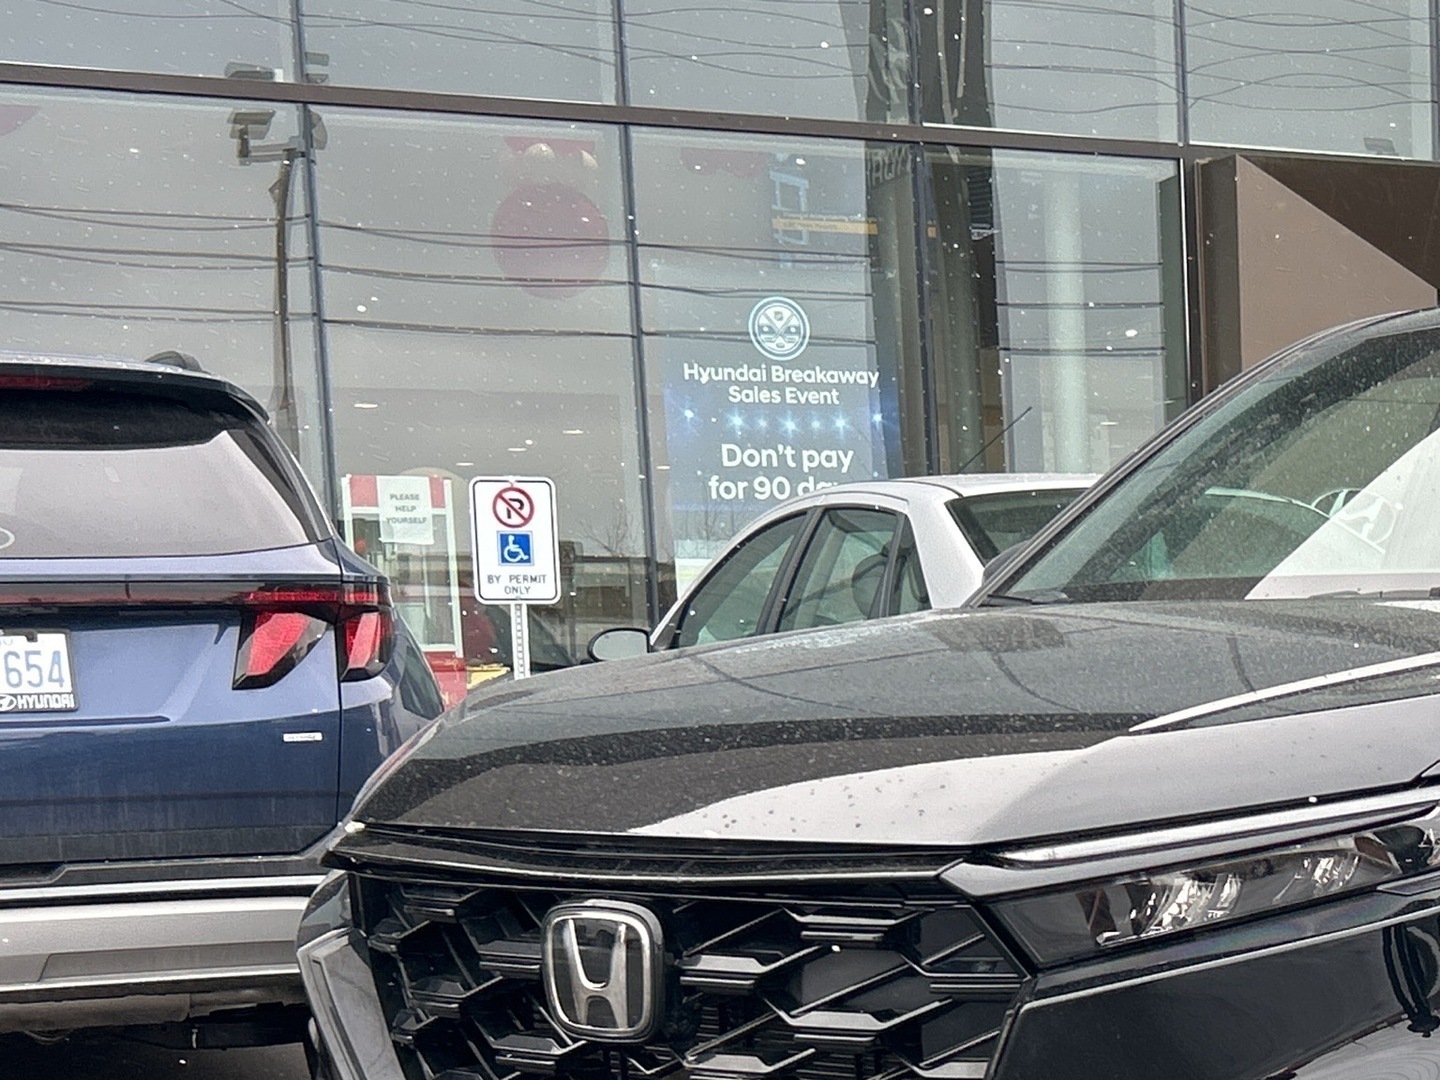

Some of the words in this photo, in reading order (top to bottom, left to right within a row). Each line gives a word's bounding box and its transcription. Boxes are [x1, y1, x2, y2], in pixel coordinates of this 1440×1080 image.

[683, 363, 767, 384] Hyundai
[771, 365, 880, 388] Breakaway
[728, 386, 781, 403] Sales
[785, 388, 840, 405] Event
[721, 443, 797, 468] Don’t
[802, 449, 854, 473] pay
[708, 475, 749, 500] for
[753, 475, 791, 500] 90
[389, 493, 420, 501] PLEASE
[395, 504, 417, 512] HELP
[386, 515, 428, 525] YOURSELF
[487, 574, 501, 585] BY
[508, 574, 548, 585] PERMIT
[504, 585, 531, 596] ONLY
[17, 692, 76, 710] HYUNDAI
